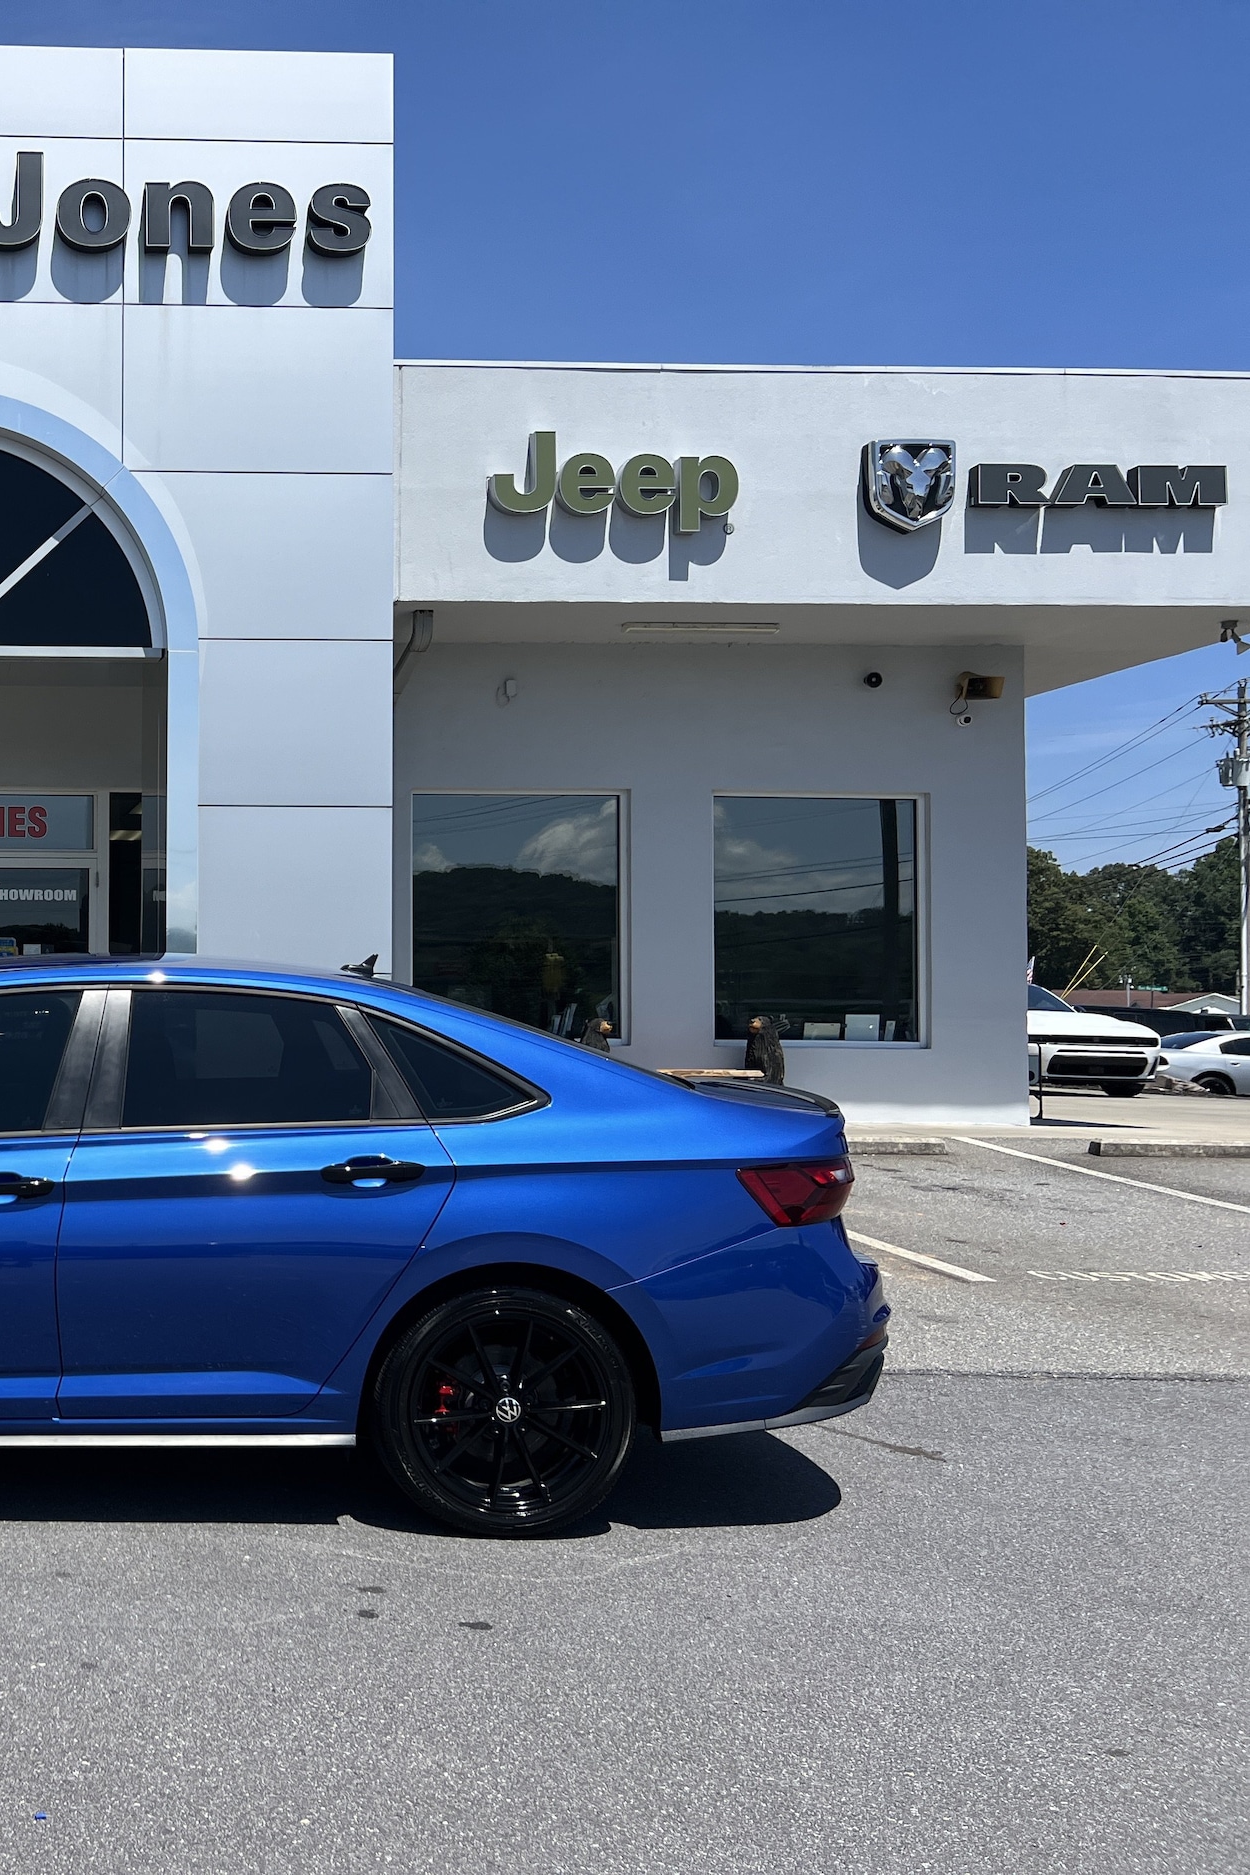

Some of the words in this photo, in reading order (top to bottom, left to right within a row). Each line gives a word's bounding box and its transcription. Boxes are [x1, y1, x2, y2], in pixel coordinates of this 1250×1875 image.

[486, 430, 740, 536] Jeep
[968, 463, 1229, 508] RAM
[1026, 1271, 1250, 1282] CUSTOME
